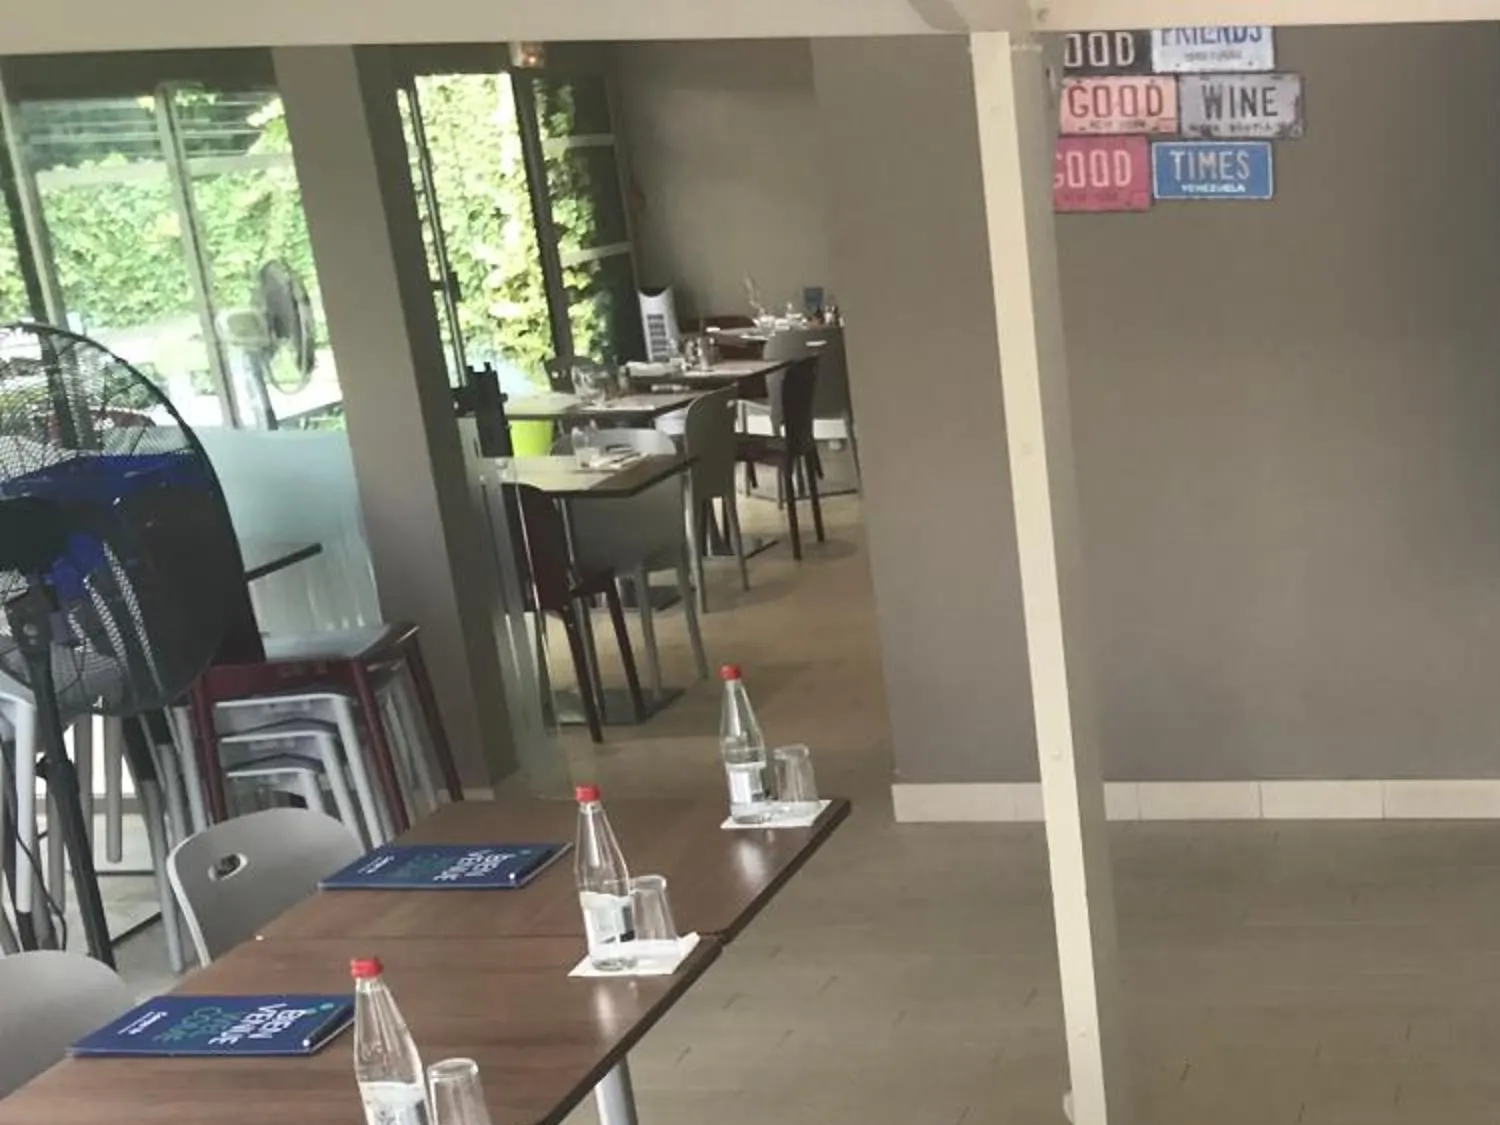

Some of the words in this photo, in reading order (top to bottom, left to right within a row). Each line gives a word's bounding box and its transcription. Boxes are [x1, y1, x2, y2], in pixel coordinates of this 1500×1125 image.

[1064, 32, 1135, 67] OOD
[1067, 84, 1163, 118] GOOD
[1201, 84, 1278, 119] WINE
[1169, 149, 1250, 181] TIMES
